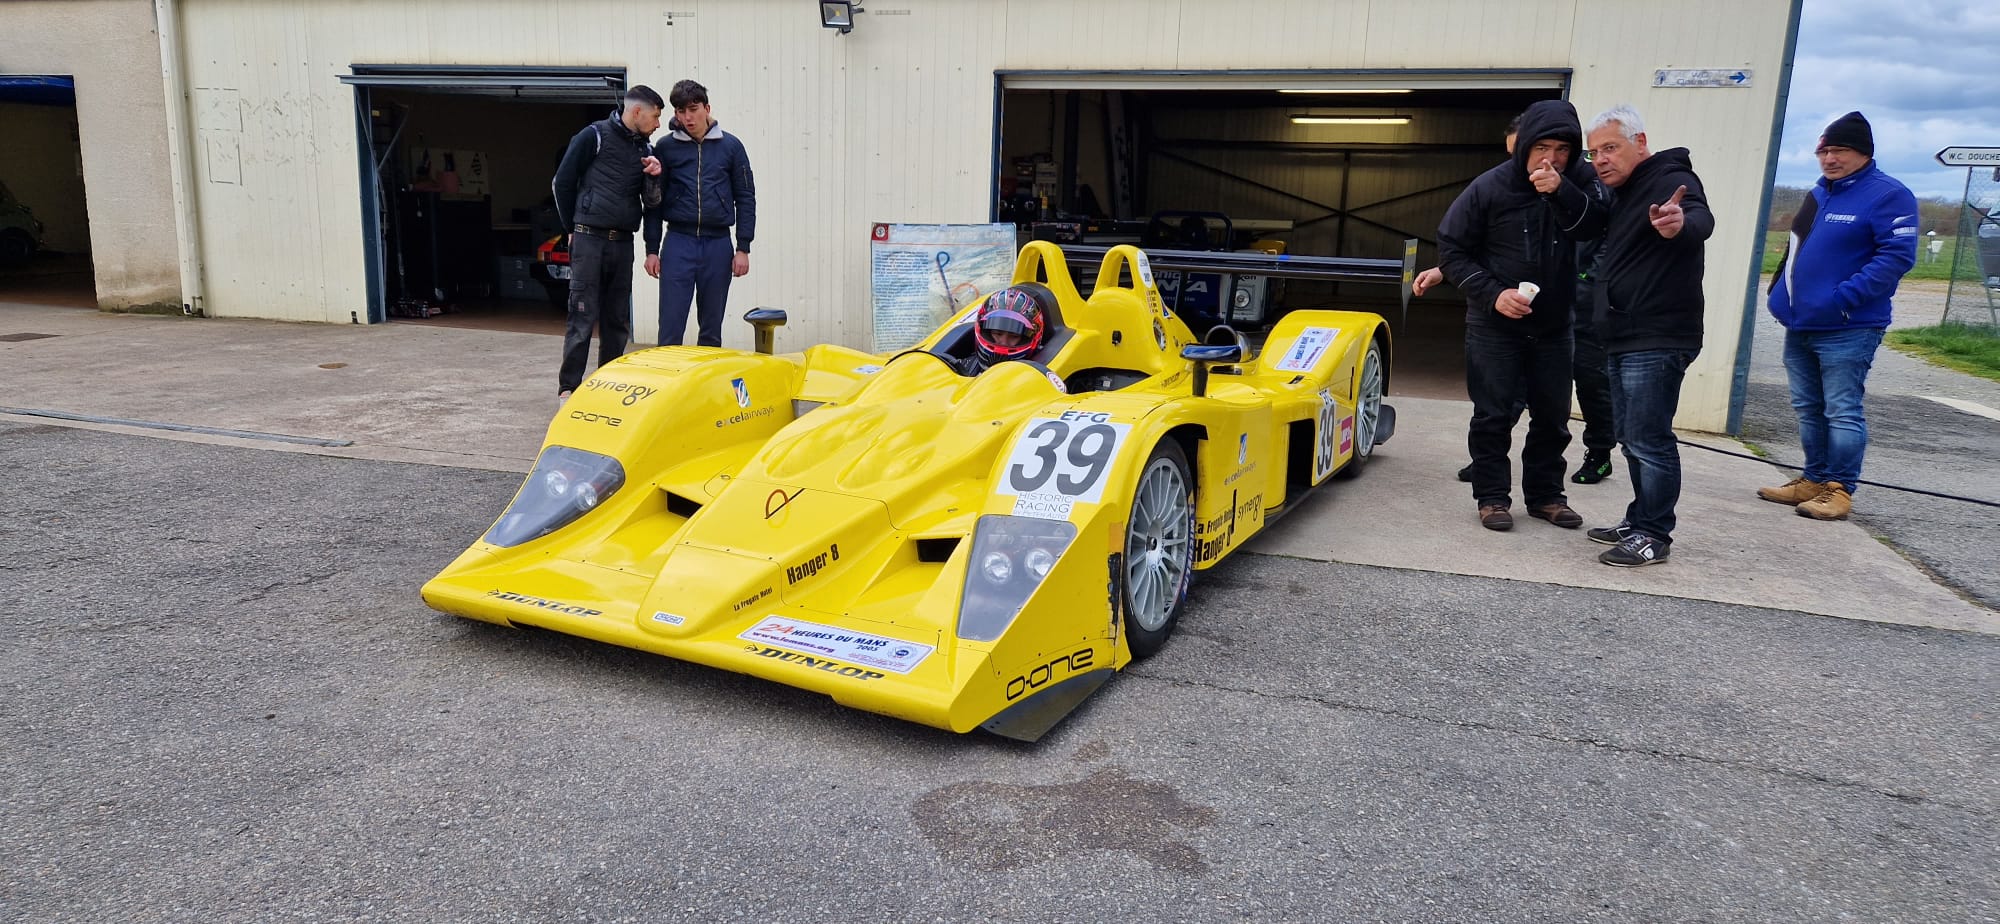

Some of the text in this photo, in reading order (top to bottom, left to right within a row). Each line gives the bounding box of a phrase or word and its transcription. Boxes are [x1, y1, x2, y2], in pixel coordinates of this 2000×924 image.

[586, 378, 658, 406] synergy
[1060, 410, 1109, 423] EFG
[1317, 403, 1335, 477] 39
[1009, 420, 1117, 496] 39
[1015, 499, 1070, 514] RACING
[1018, 491, 1073, 503] HISTORIC
[786, 543, 840, 586] Hanger 8
[496, 591, 603, 616] DUNLOP
[759, 623, 889, 648] 24 HEURES DU MANS
[756, 647, 885, 681] DUNLOP
